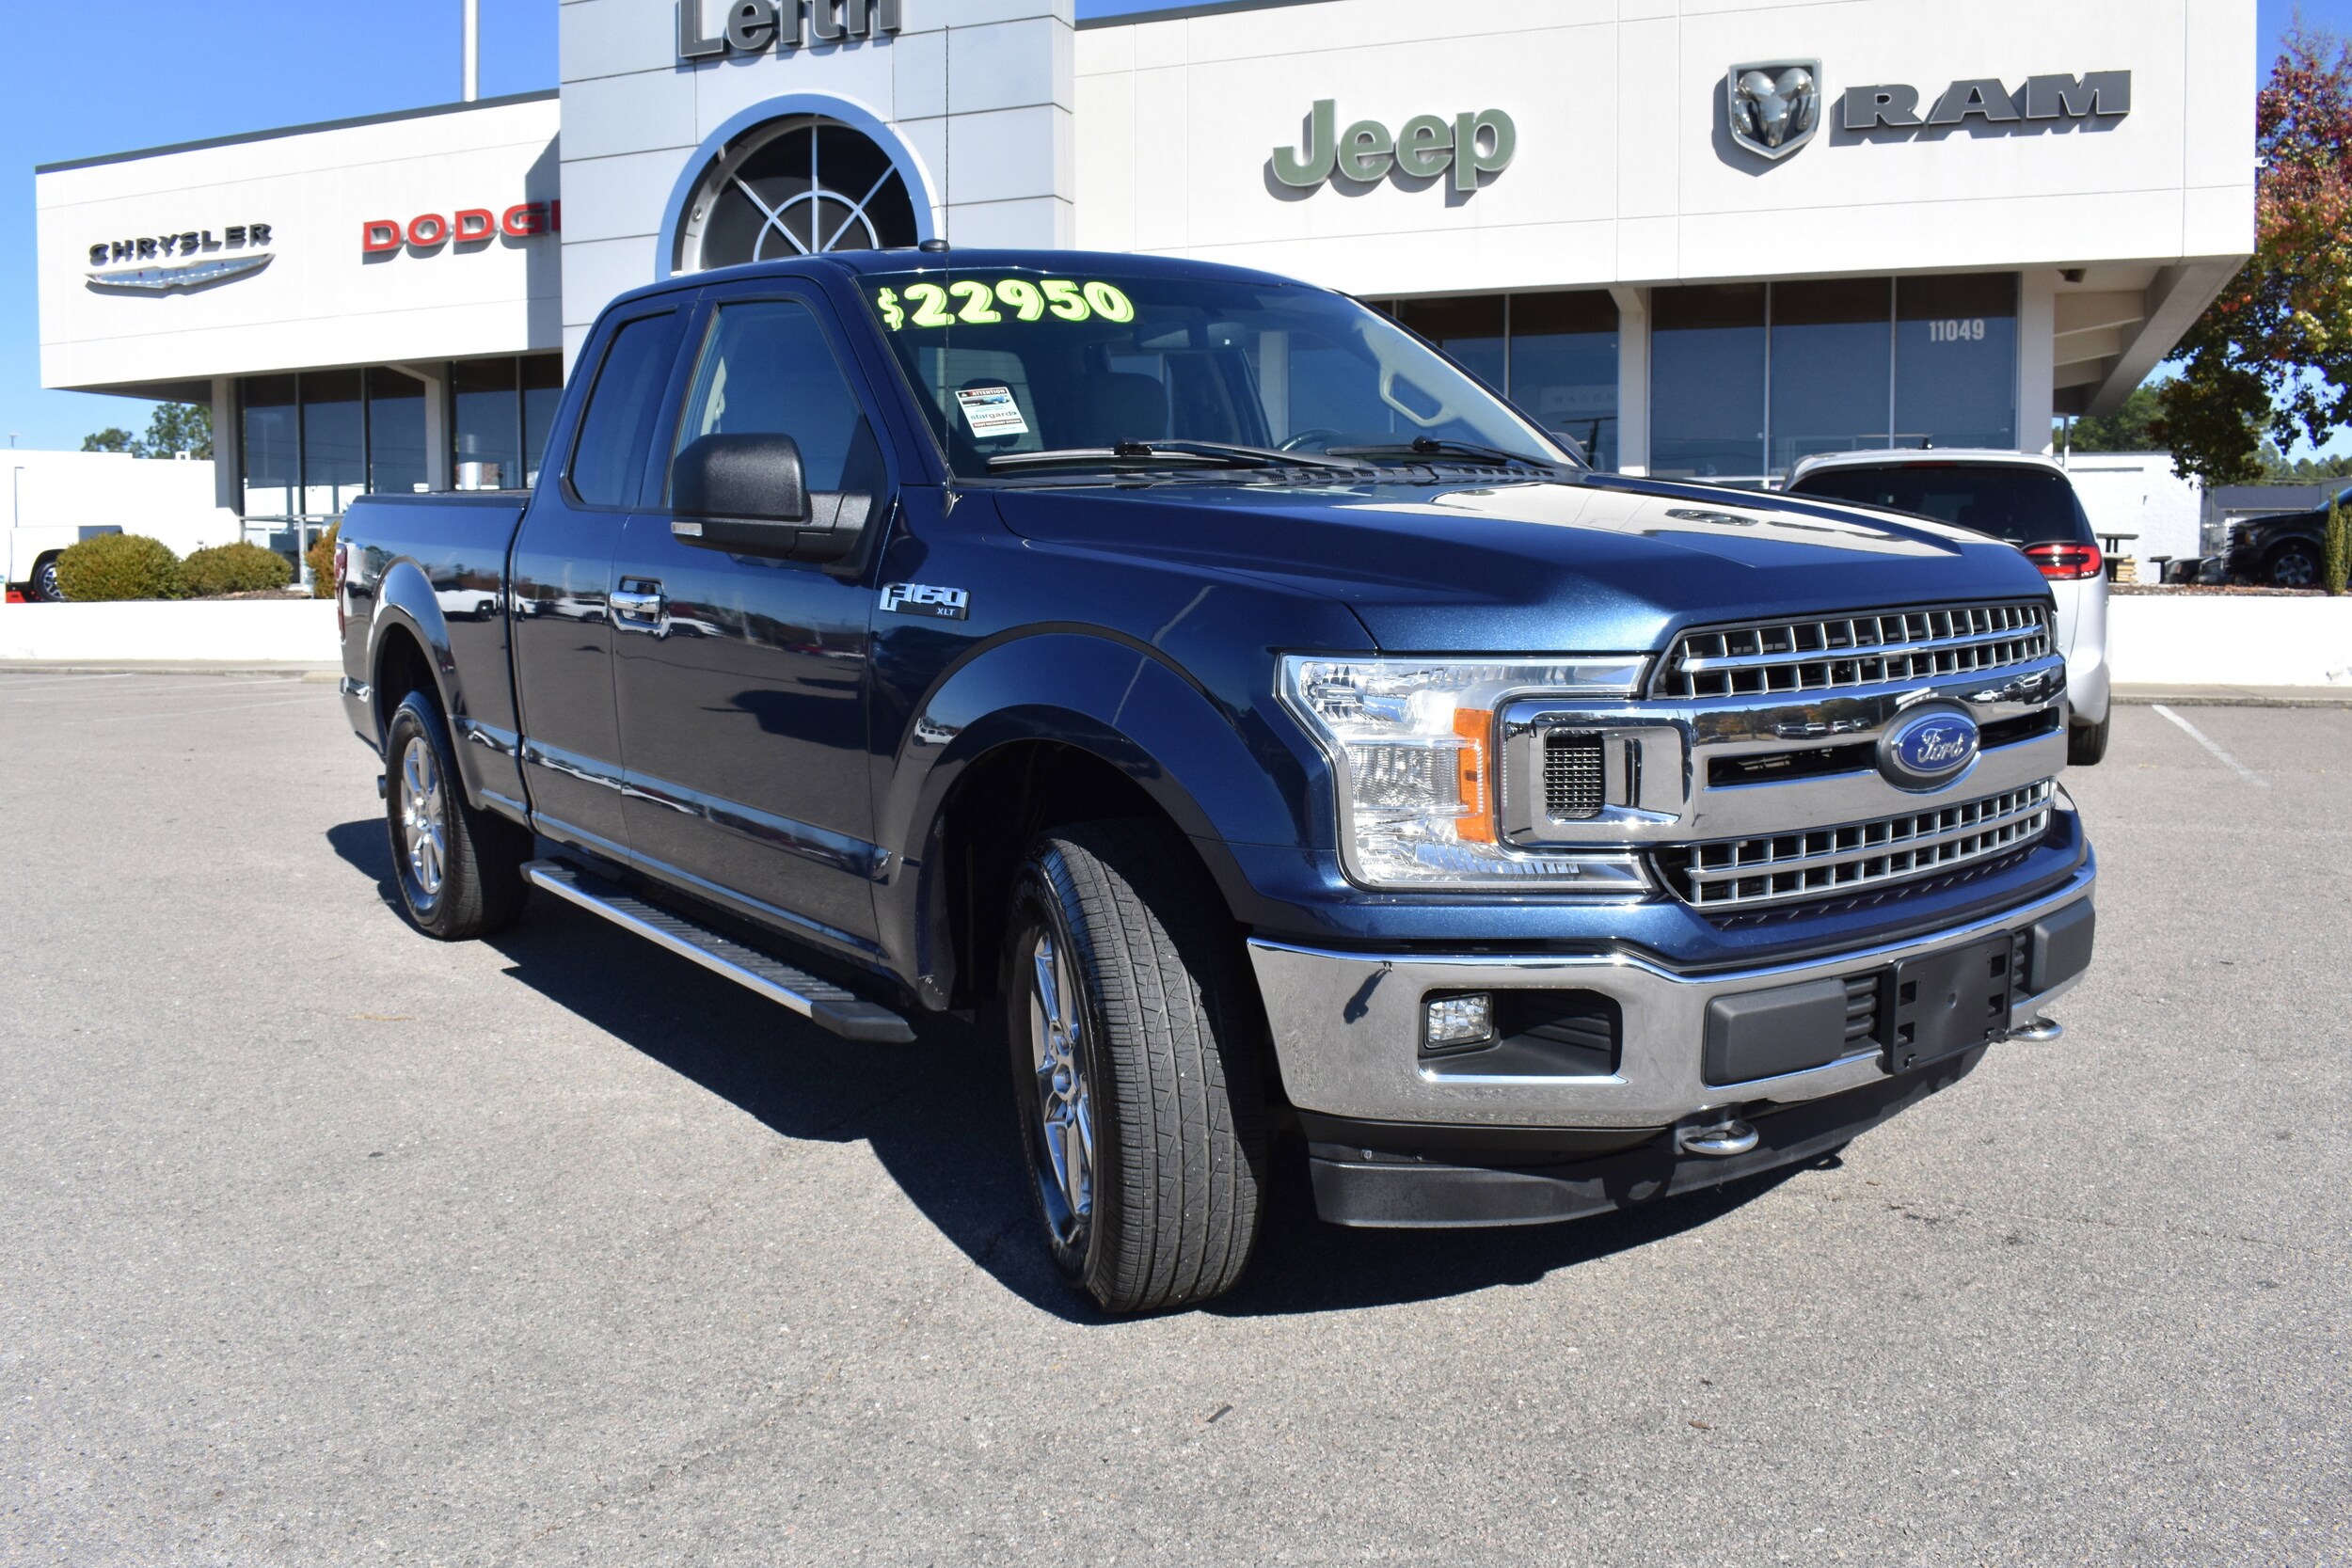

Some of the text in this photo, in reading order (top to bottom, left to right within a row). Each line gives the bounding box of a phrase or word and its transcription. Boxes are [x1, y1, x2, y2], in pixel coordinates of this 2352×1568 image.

[1844, 70, 2132, 129] RAM
[1272, 99, 1517, 191] Jeep
[89, 223, 273, 266] CHRYSLER
[878, 279, 1135, 331] $22950
[1929, 318, 1985, 341] 11049
[937, 608, 956, 616] XLT
[1917, 727, 1964, 764] Ford
